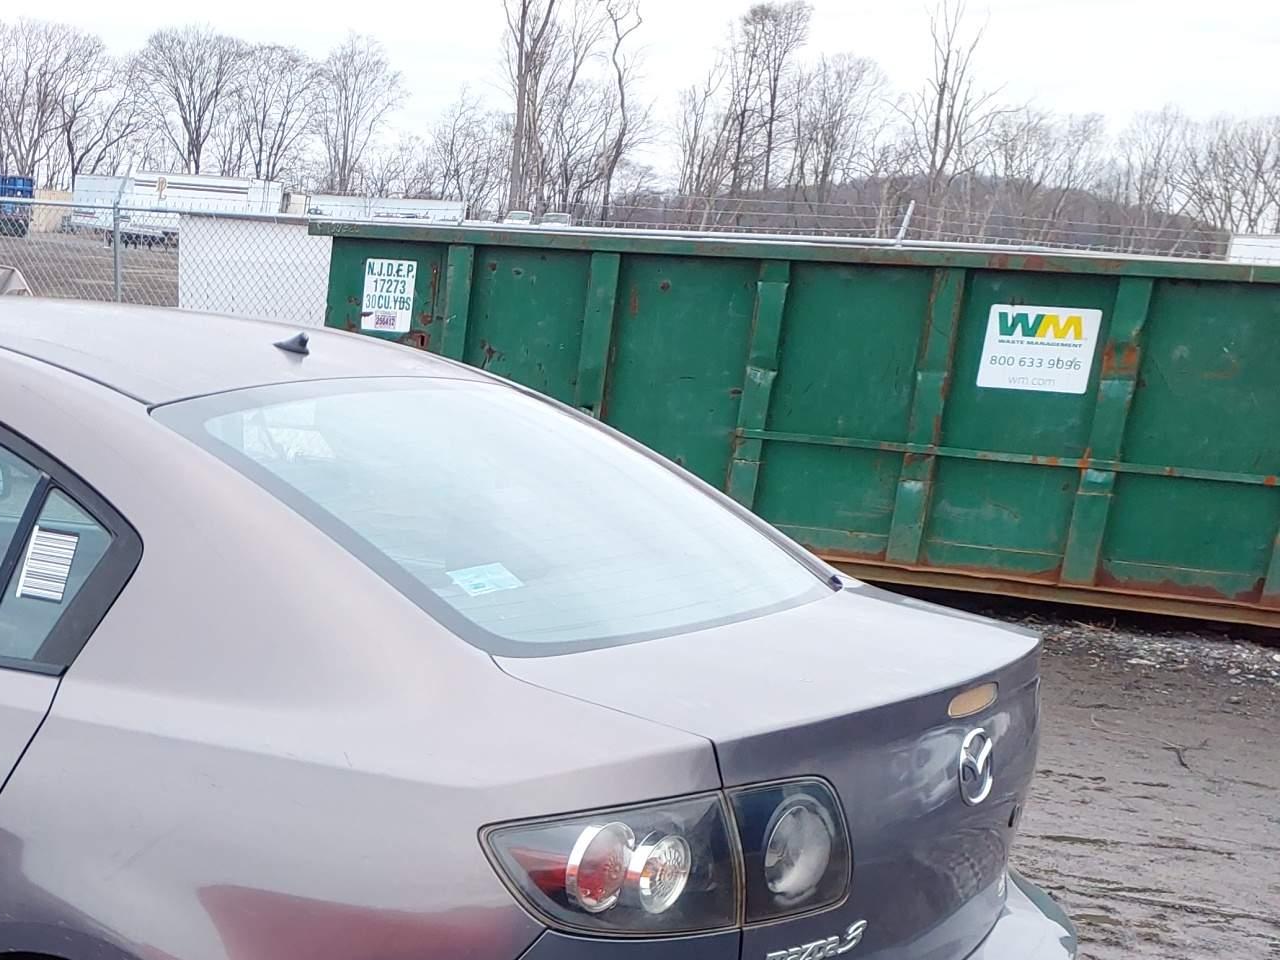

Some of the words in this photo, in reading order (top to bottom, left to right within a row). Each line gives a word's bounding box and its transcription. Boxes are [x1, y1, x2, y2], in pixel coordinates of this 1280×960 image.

[367, 261, 415, 279] N.J.D.E.P.
[373, 279, 406, 294] 17273
[998, 311, 1083, 340] WM
[1026, 340, 1083, 348] MANAGEMENT
[989, 355, 1015, 367] 800
[1018, 357, 1043, 368] 633
